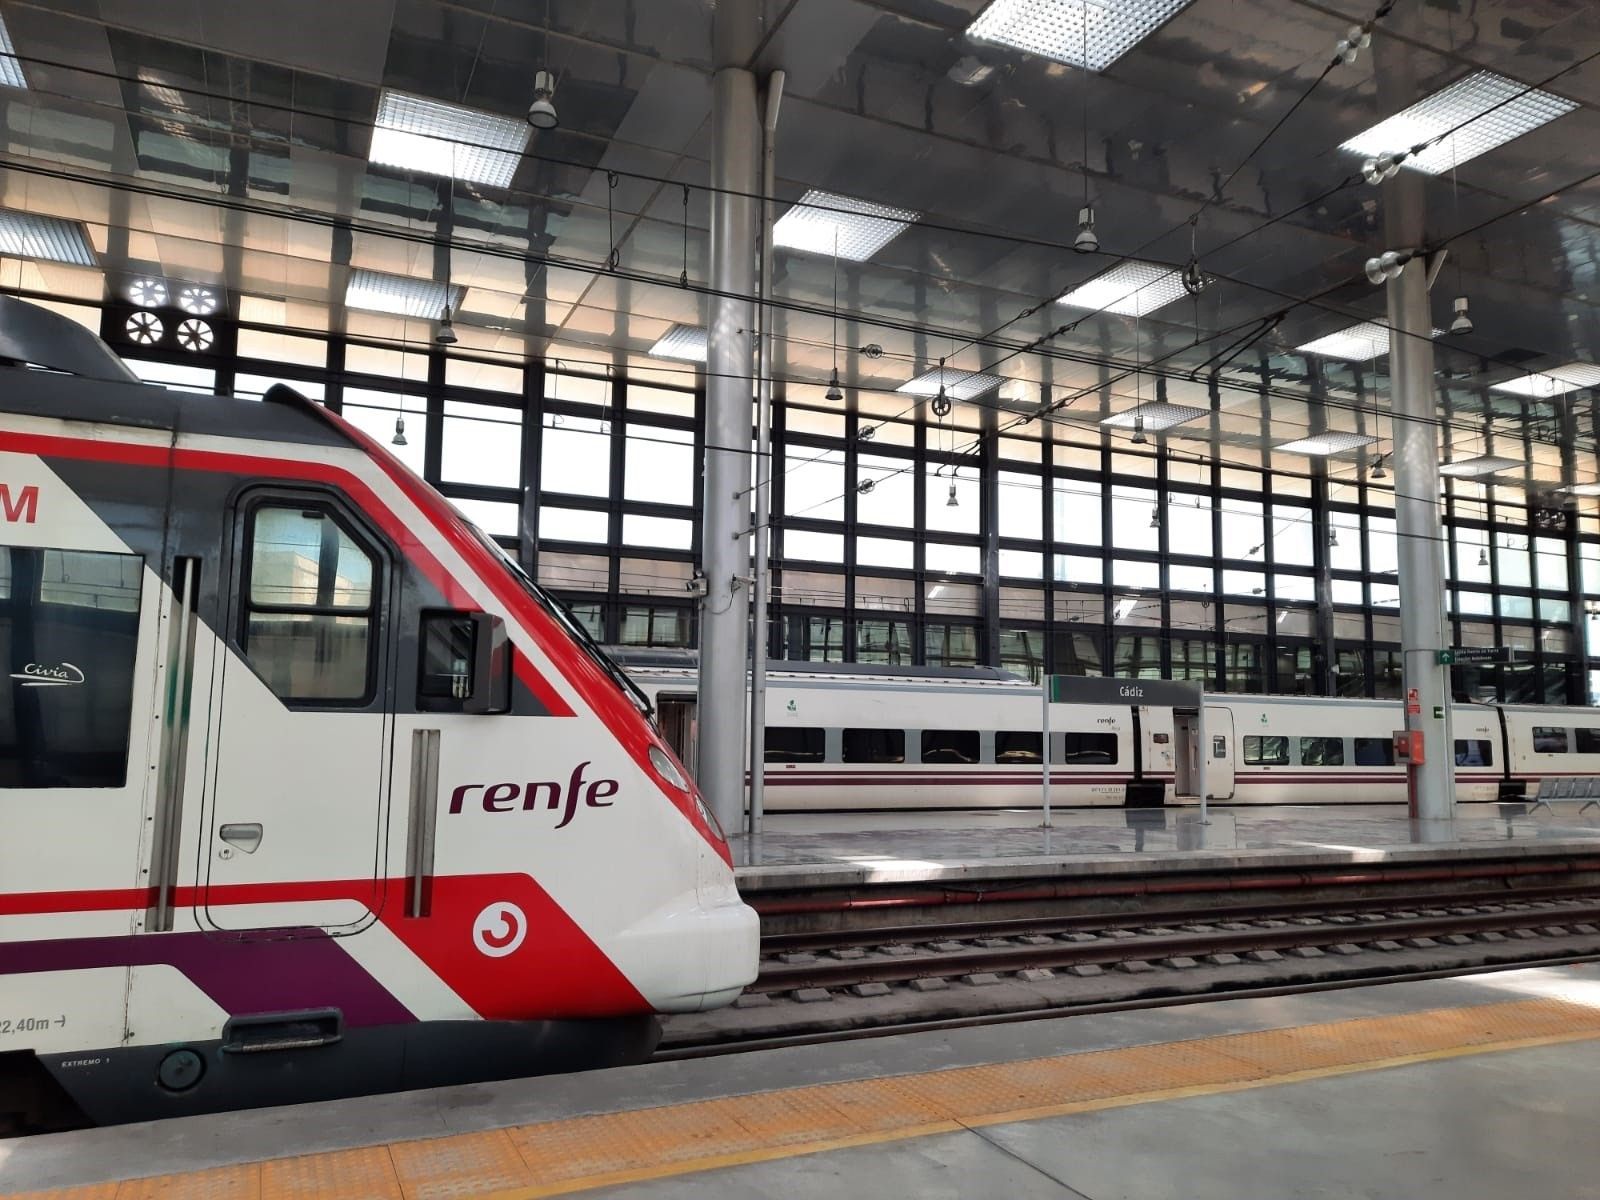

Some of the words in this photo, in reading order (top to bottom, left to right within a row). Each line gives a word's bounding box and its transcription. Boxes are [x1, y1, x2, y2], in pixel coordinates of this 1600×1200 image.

[25, 663, 69, 679] Civia
[1119, 686, 1144, 697] Cádiz
[449, 761, 619, 829] renfe
[0, 1018, 49, 1034] 2,40m
[61, 1058, 101, 1068] EXTREMO
